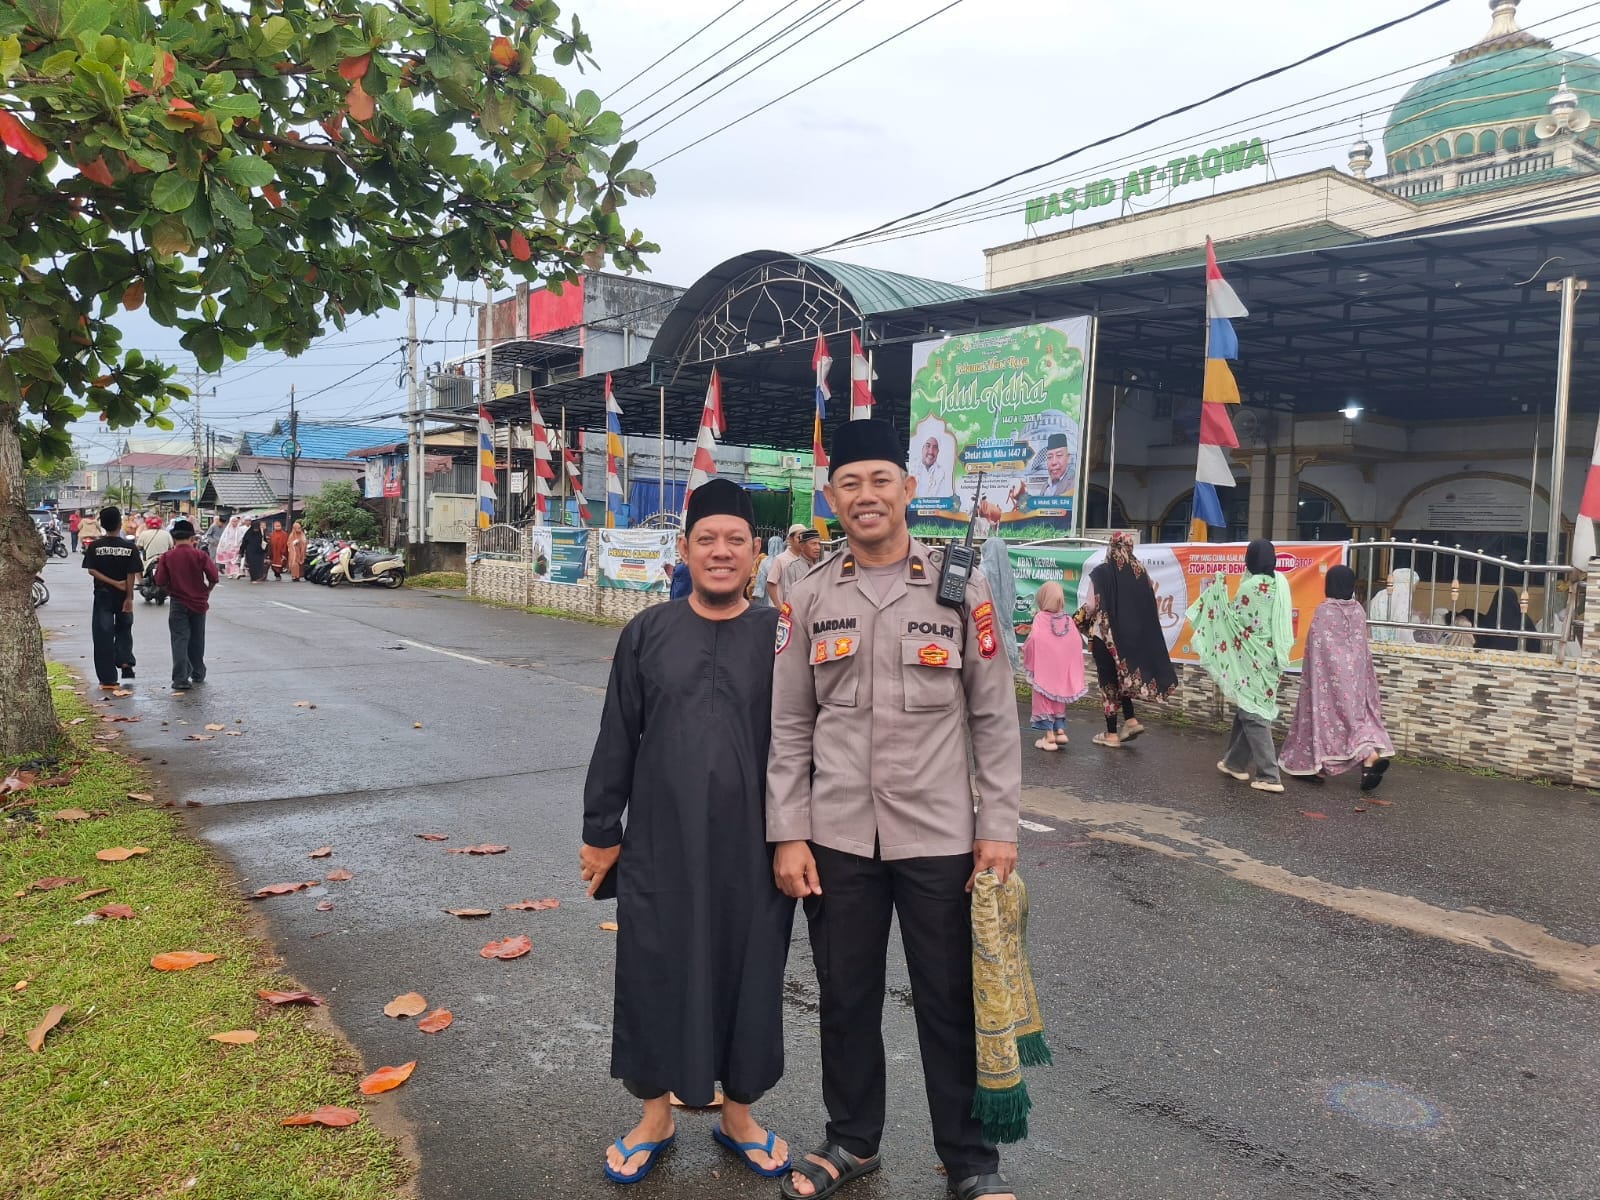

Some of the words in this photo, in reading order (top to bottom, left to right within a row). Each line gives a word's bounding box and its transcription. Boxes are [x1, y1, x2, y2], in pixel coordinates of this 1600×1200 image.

[1025, 177, 1116, 225] MASJID
[937, 374, 981, 415] Idul
[981, 369, 1048, 414] Adha
[1200, 554, 1212, 562] YANG
[1212, 554, 1226, 562] CUMA
[1226, 554, 1238, 562] ASAL
[1032, 569, 1064, 580] LAMBUNG
[1189, 564, 1204, 574] STOP
[1206, 563, 1227, 573] DIARE
[812, 618, 857, 634] MARDANI
[907, 622, 954, 638] POLRI
